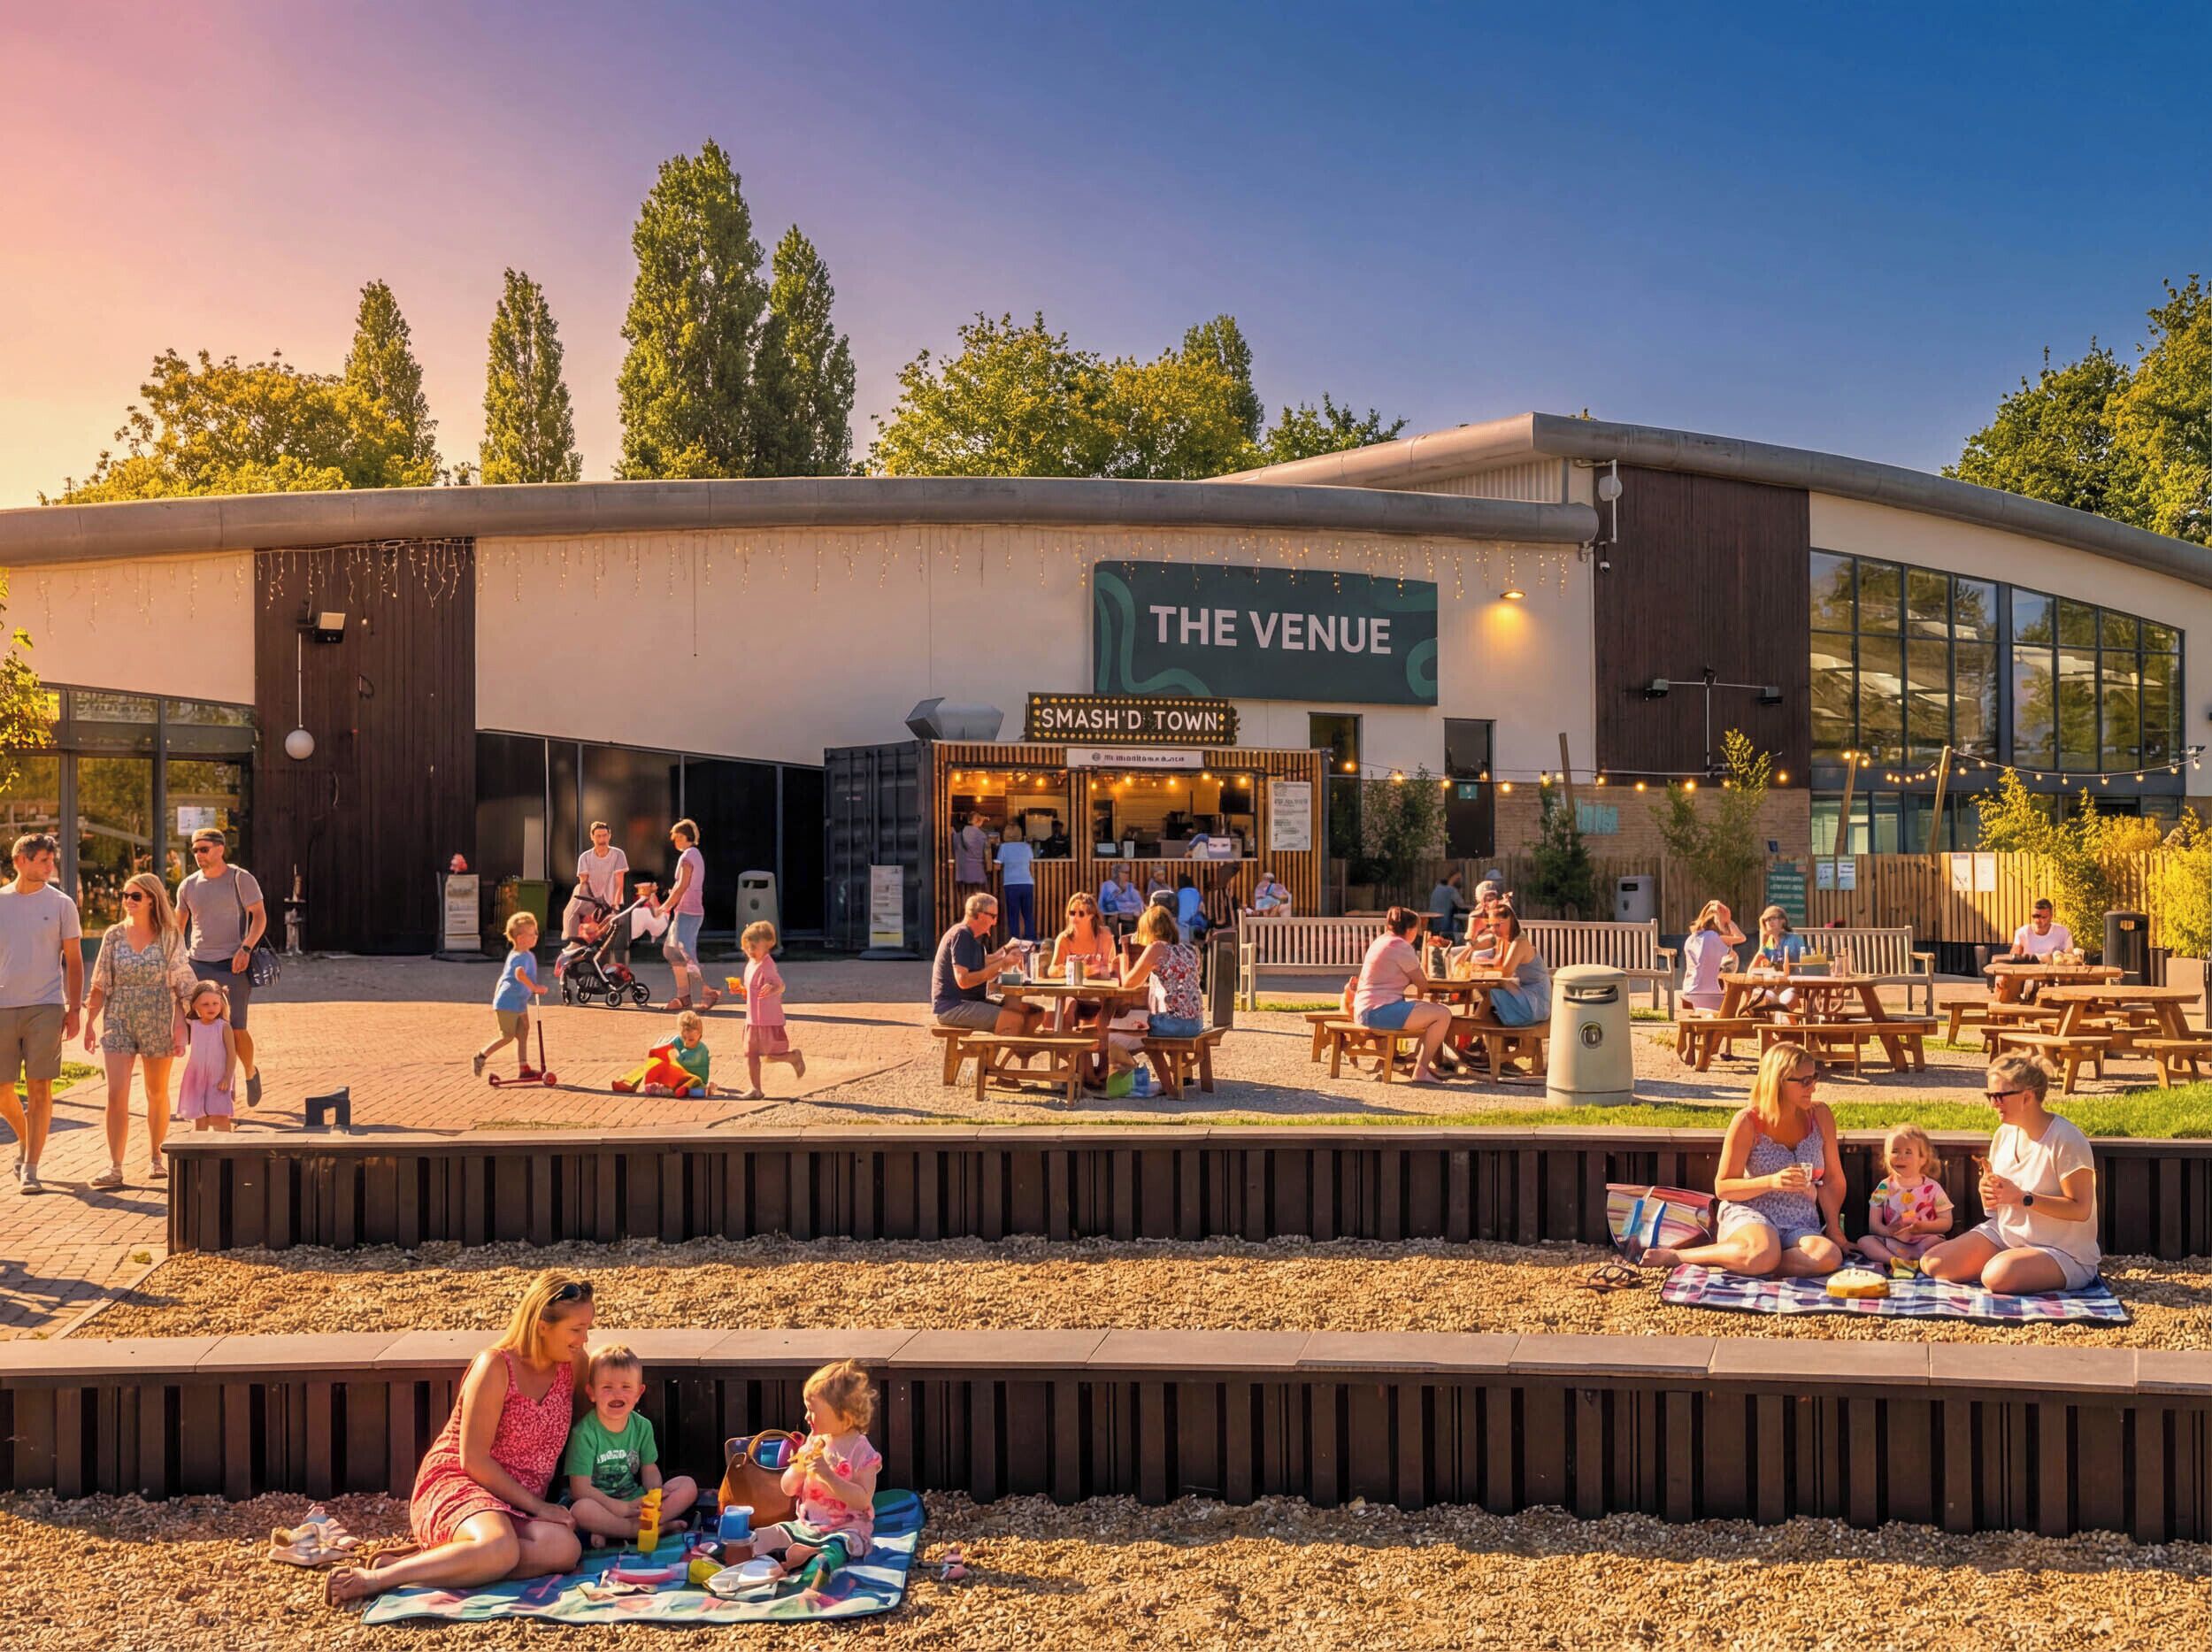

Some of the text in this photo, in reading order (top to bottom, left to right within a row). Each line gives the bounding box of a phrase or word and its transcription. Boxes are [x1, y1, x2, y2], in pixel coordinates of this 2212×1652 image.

[1150, 605, 1392, 655] THE VENUE
[1041, 708, 1217, 731] SMASH'D TOWN
